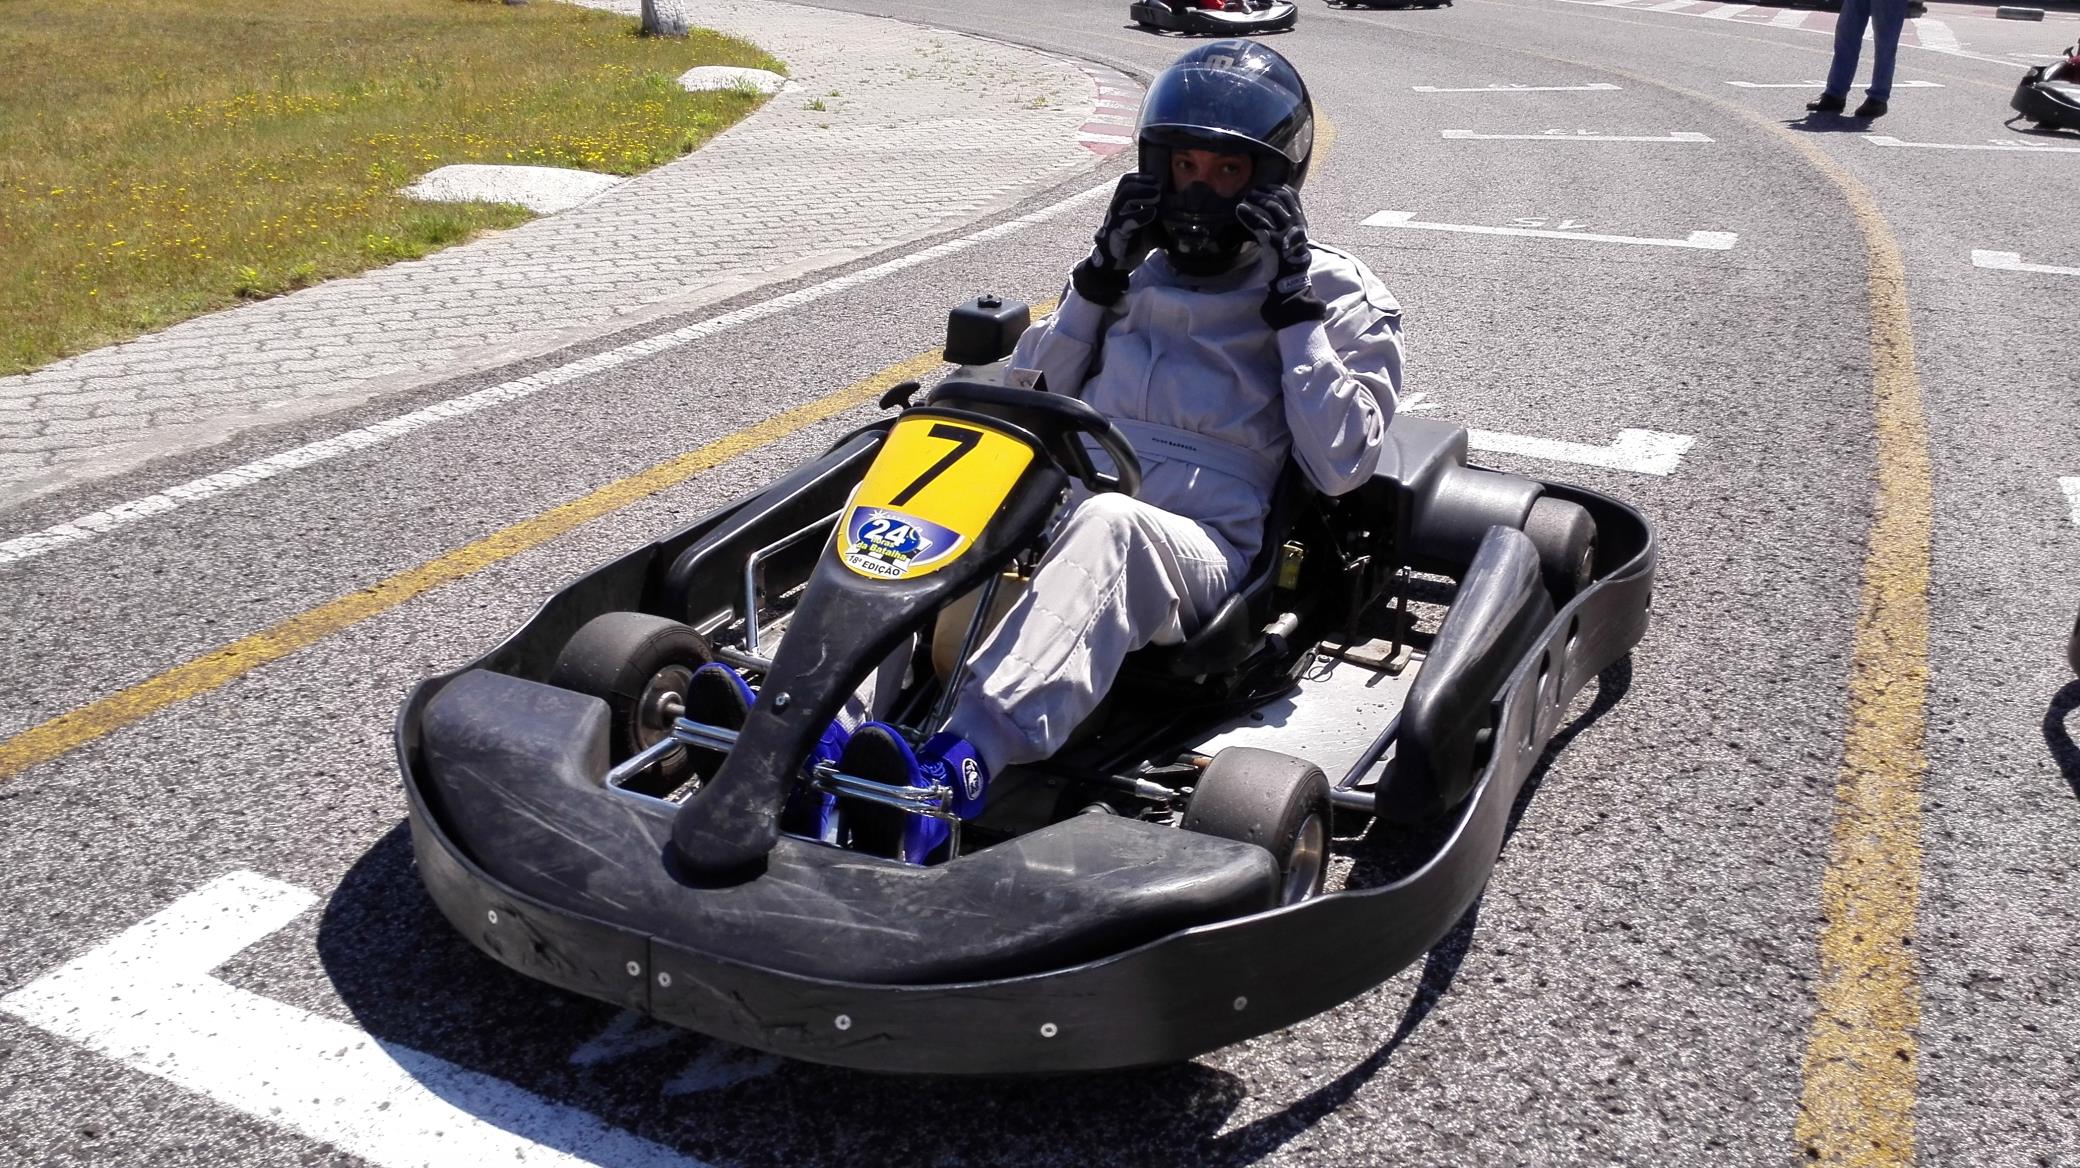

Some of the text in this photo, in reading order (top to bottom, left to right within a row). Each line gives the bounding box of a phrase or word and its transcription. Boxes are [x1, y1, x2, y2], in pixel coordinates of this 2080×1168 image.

[888, 423, 985, 507] 7
[864, 518, 911, 546] 24
[856, 540, 908, 562] da Batalha
[862, 559, 900, 576] EDIÇÃO
